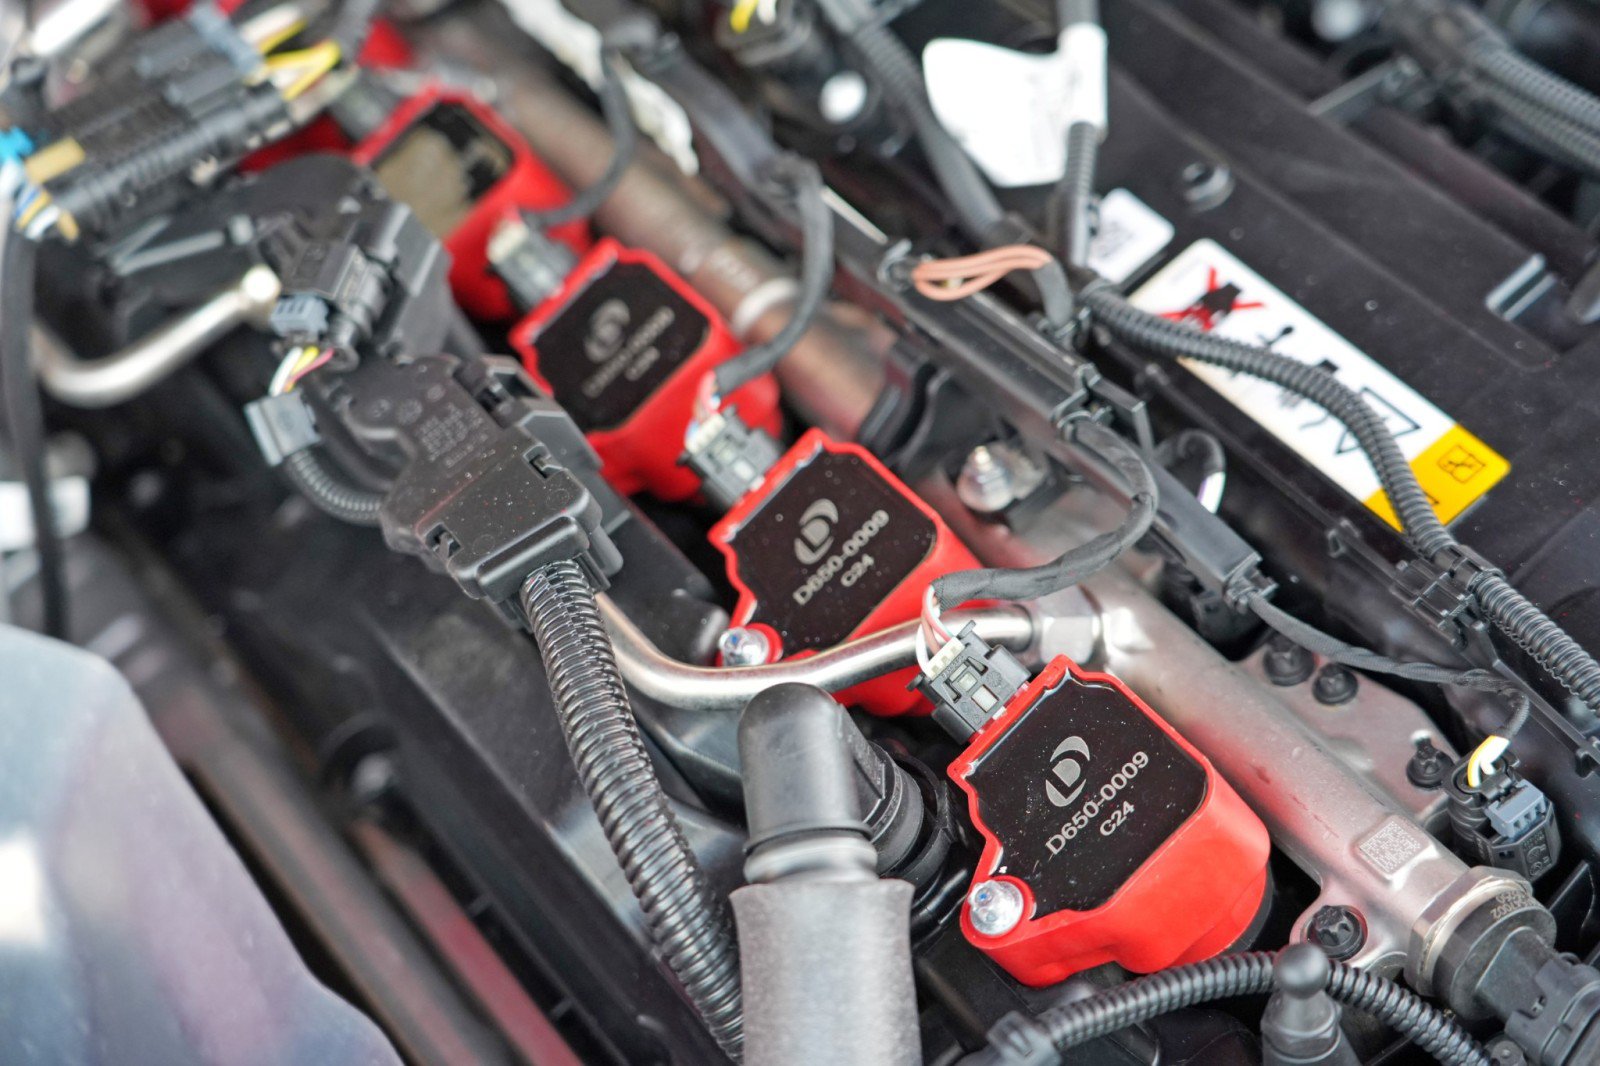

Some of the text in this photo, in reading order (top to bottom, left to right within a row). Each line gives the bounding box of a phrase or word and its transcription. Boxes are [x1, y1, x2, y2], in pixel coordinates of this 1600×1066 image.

[792, 509, 890, 605] D650-0009
[840, 553, 875, 588] C24
[1045, 751, 1149, 855] D650-0009
[1099, 800, 1135, 836] C24
